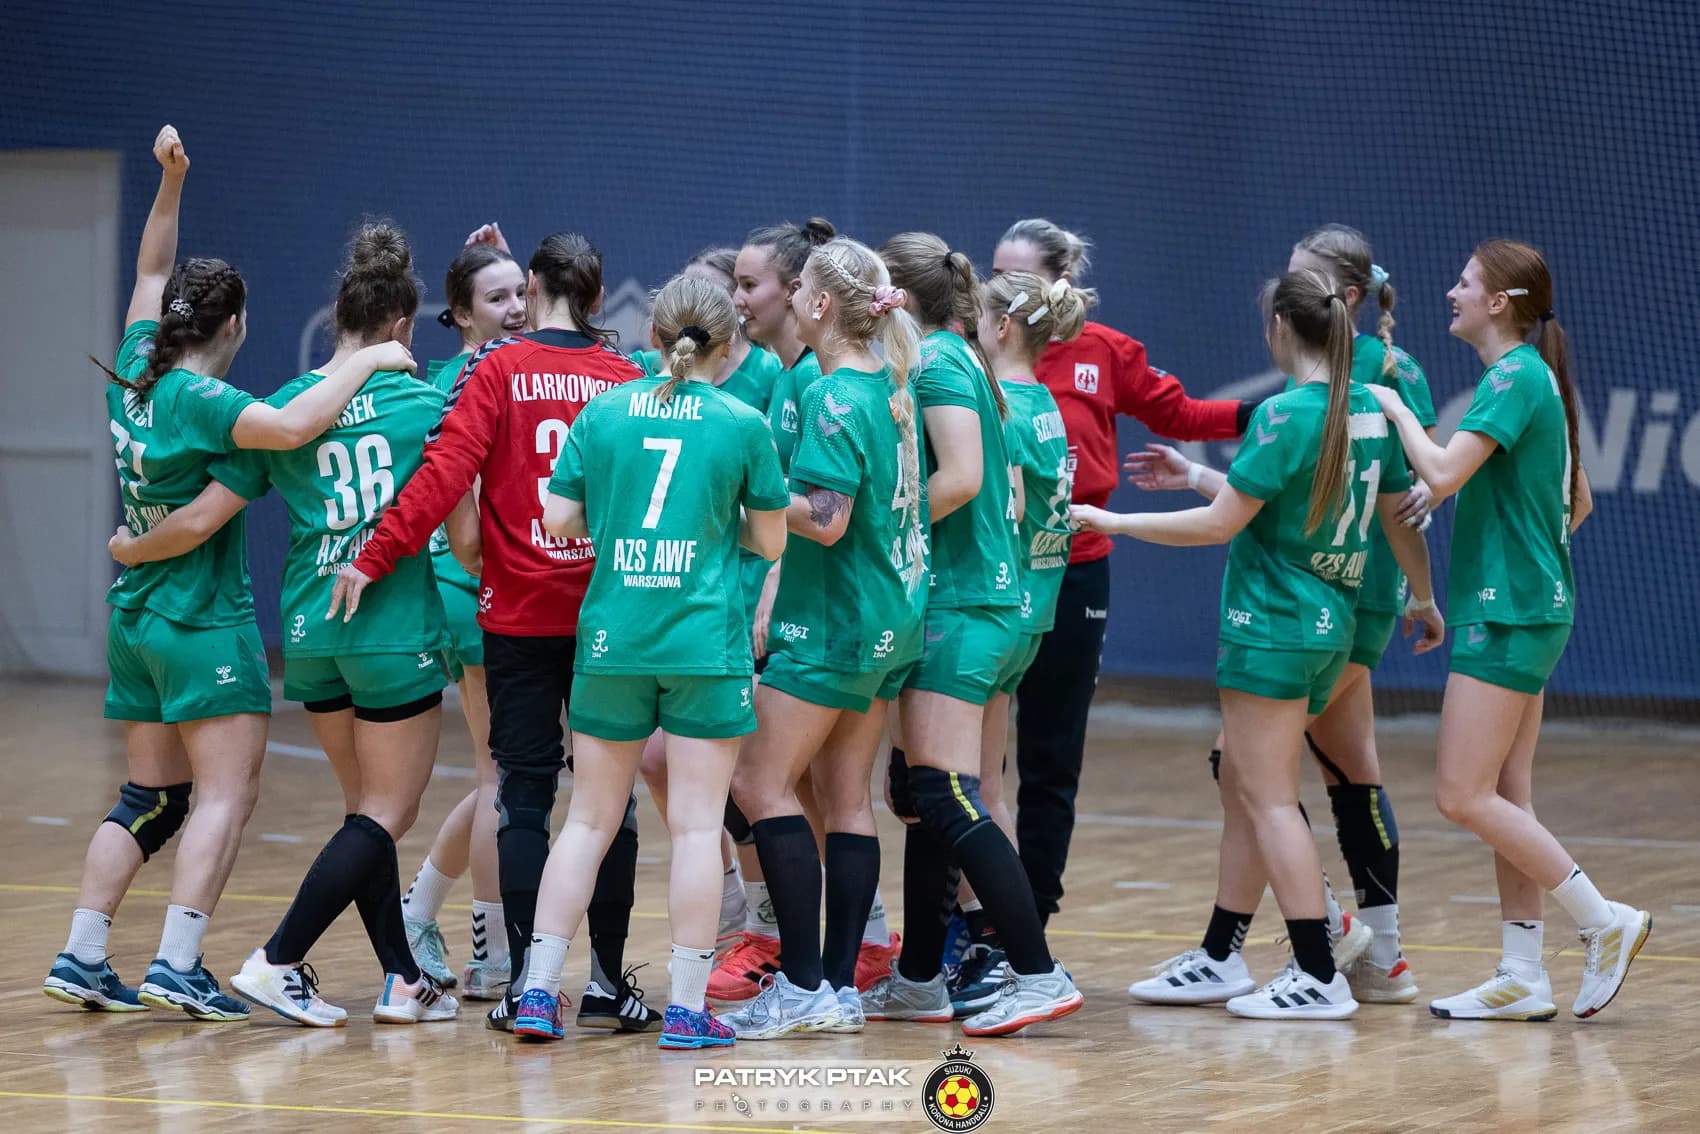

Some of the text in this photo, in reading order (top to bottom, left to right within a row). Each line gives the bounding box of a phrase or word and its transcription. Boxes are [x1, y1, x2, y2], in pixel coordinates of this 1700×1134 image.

[628, 392, 702, 421] MUSIAŁ
[316, 433, 394, 530] 36
[642, 437, 682, 529] 7
[613, 540, 697, 573] AZS AWF
[623, 574, 681, 589] WARSZAWA
[780, 621, 810, 639] YOGI
[1227, 607, 1252, 625] YOGI
